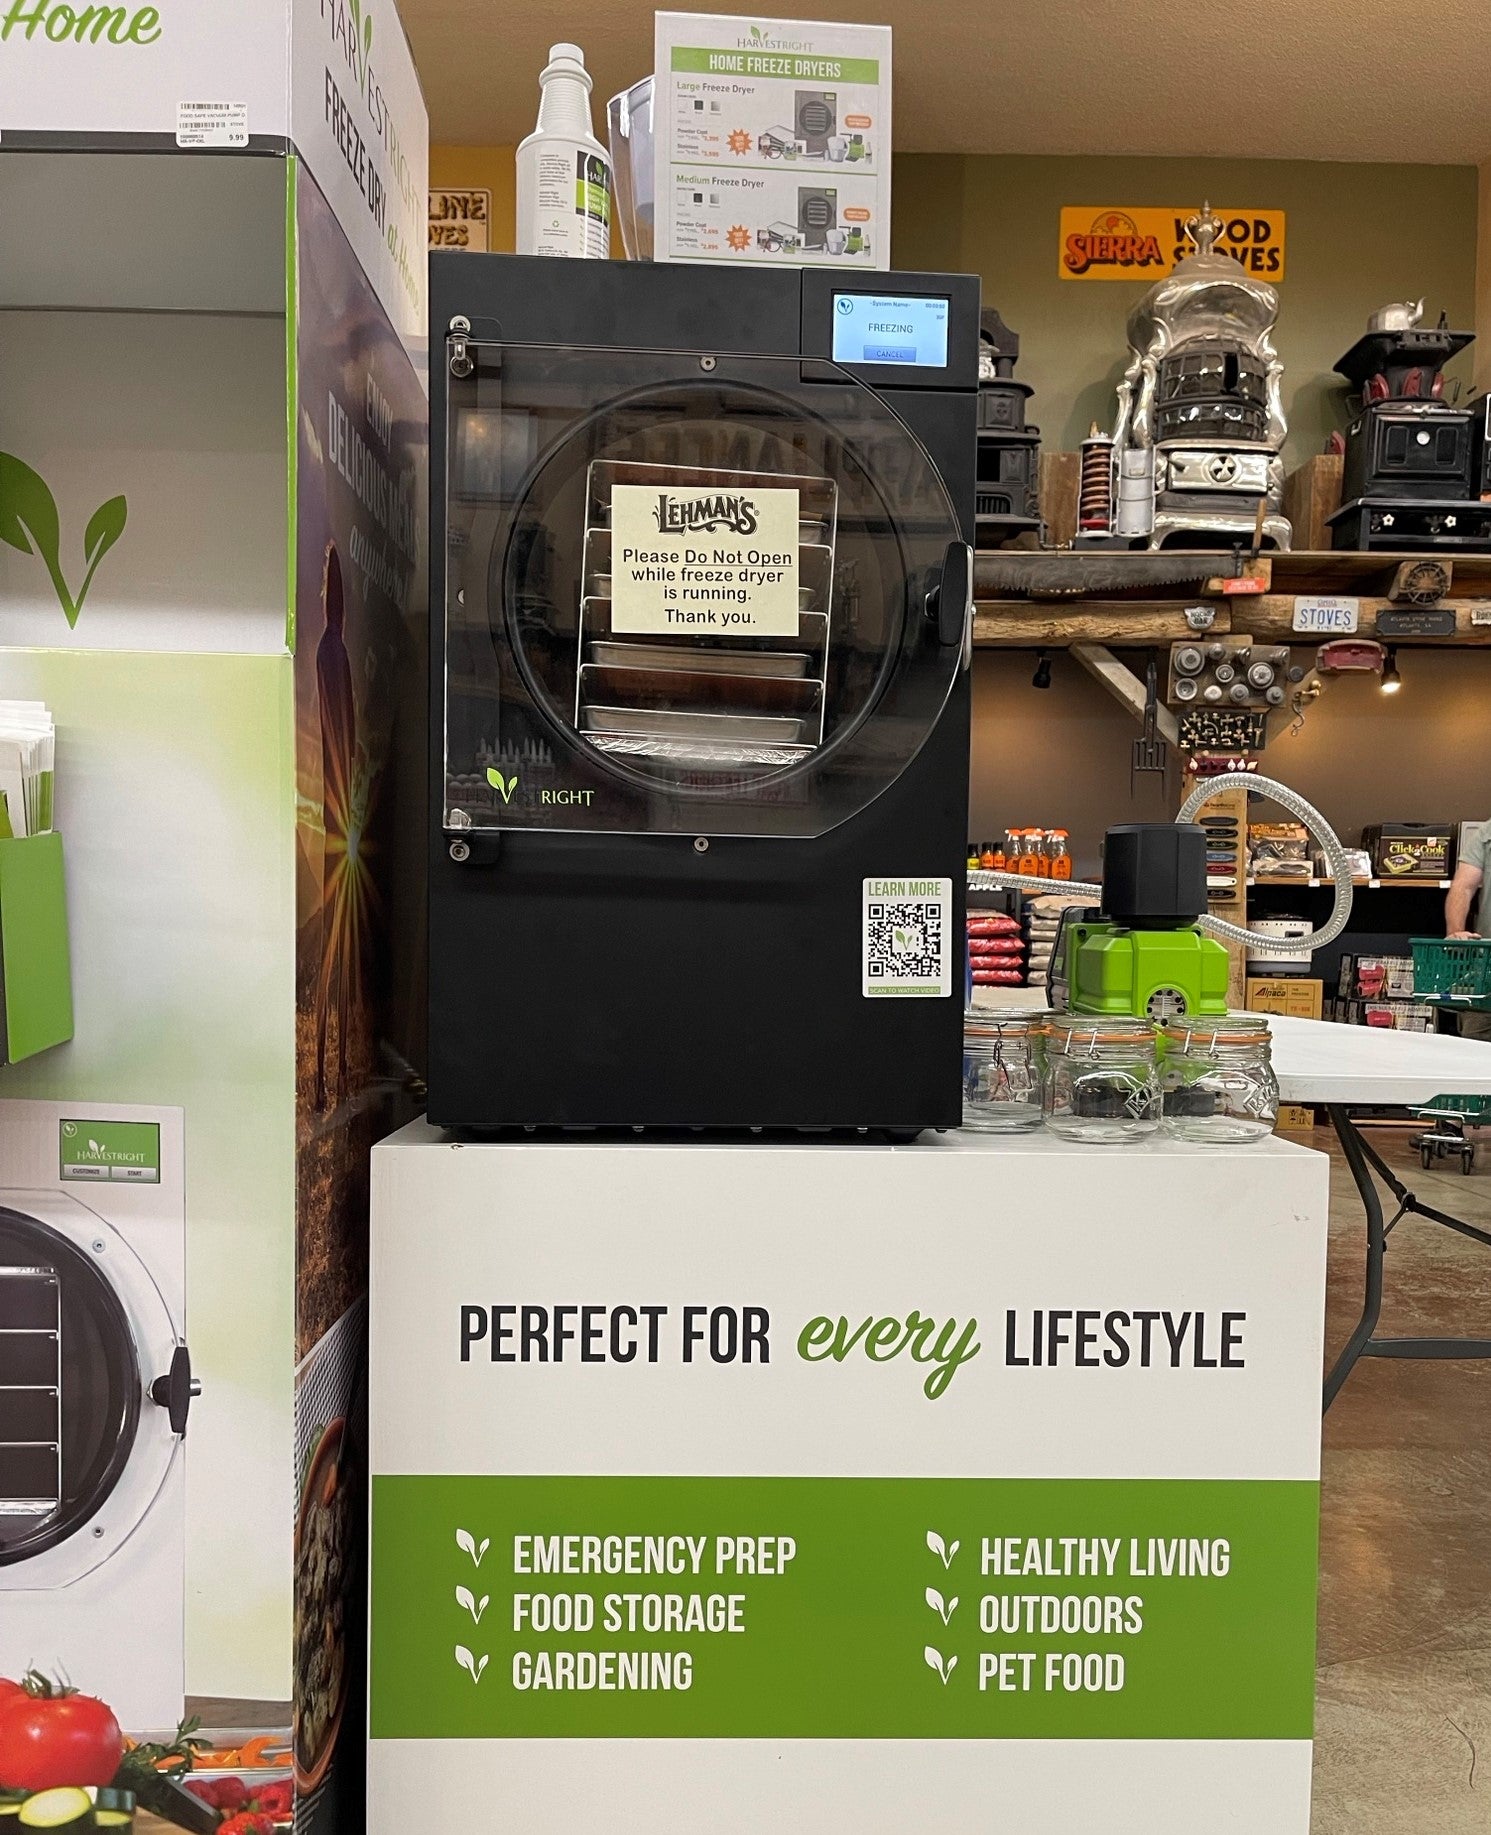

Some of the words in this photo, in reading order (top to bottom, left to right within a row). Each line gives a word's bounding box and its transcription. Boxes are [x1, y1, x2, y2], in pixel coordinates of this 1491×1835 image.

[0, 0, 162, 45] Home
[737, 37, 814, 52] HARVESTRIGHT
[709, 54, 744, 73] HOME
[747, 56, 792, 75] FREEZE
[795, 60, 841, 78] DRYERS
[676, 81, 700, 92] Large
[702, 83, 731, 93] Freeze
[732, 84, 755, 95] Dryer
[325, 65, 366, 198] FREEZE
[368, 156, 387, 237] DRY
[676, 174, 710, 184] Medium
[711, 176, 740, 187] Freeze
[741, 178, 765, 189] Dryer
[1063, 233, 1165, 275] SIERRA
[868, 323, 914, 334] FREEZING
[876, 350, 904, 359] CANCEL
[366, 371, 394, 454] ENJOY
[328, 389, 388, 530] DELICIOUS
[652, 493, 758, 536] LEHMAN'S
[623, 548, 679, 564] Please
[685, 549, 708, 564] Do
[713, 549, 743, 564] Not
[747, 549, 792, 567] Open
[632, 567, 675, 582] while
[681, 568, 733, 582] freeze
[738, 568, 784, 585] dryer
[664, 585, 677, 600] is
[683, 586, 752, 603] running.
[665, 608, 716, 624] Thank
[721, 611, 756, 626] you.
[1300, 608, 1352, 626] STOVES
[541, 789, 595, 808] RIGHT
[1389, 844, 1415, 854] Click
[1420, 844, 1446, 854] Cook
[868, 881, 906, 897] LEARN
[908, 881, 942, 897] MORE
[1255, 986, 1287, 998] Alpaca
[77, 1150, 146, 1163] HARVESTRIGHT
[459, 1303, 669, 1364] PERFECT
[682, 1304, 771, 1364] FOR
[798, 1309, 982, 1401] every
[1005, 1309, 1247, 1368] LIFESTYLE
[513, 1535, 707, 1575] EMERGENCY
[715, 1536, 797, 1575] PREP
[980, 1537, 1122, 1577] HEALTHY
[1129, 1538, 1231, 1578] LIVING
[513, 1593, 595, 1632] FOOD
[602, 1594, 746, 1633] STORAGE
[979, 1594, 1144, 1635] OUTDOORS
[512, 1651, 693, 1691] GARDENING
[978, 1653, 1036, 1692] PET
[1045, 1653, 1125, 1692] FOOD
